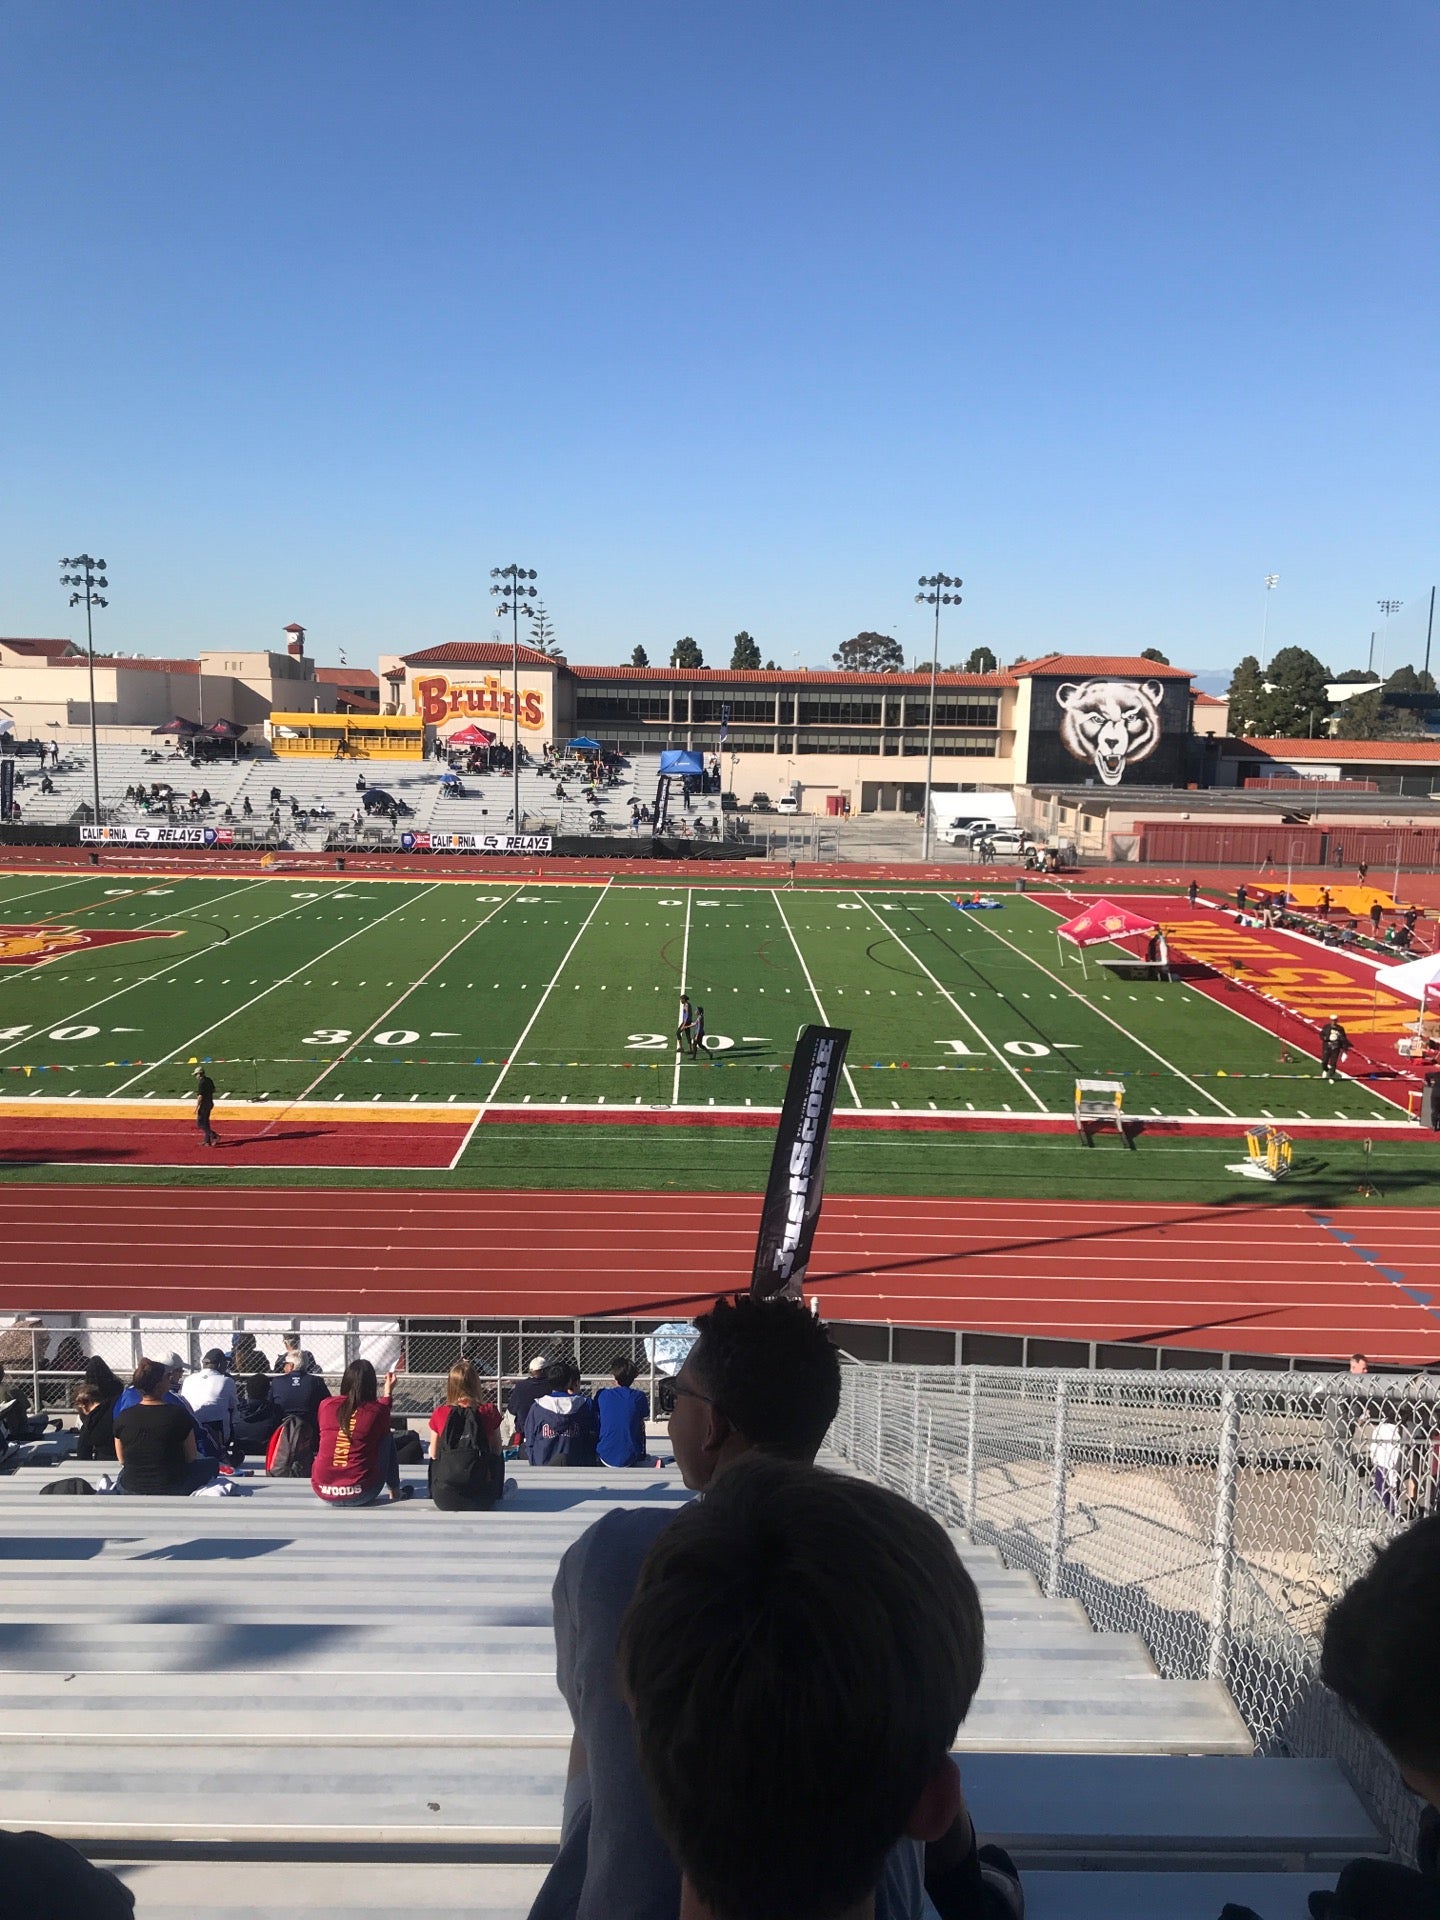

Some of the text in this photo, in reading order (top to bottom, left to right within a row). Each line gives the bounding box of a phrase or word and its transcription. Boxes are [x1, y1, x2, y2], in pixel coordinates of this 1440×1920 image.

[417, 676, 545, 725] Bruins
[157, 828, 201, 842] RELAYS
[506, 836, 550, 849] RELAYS
[318, 1484, 362, 1496] WOODS
